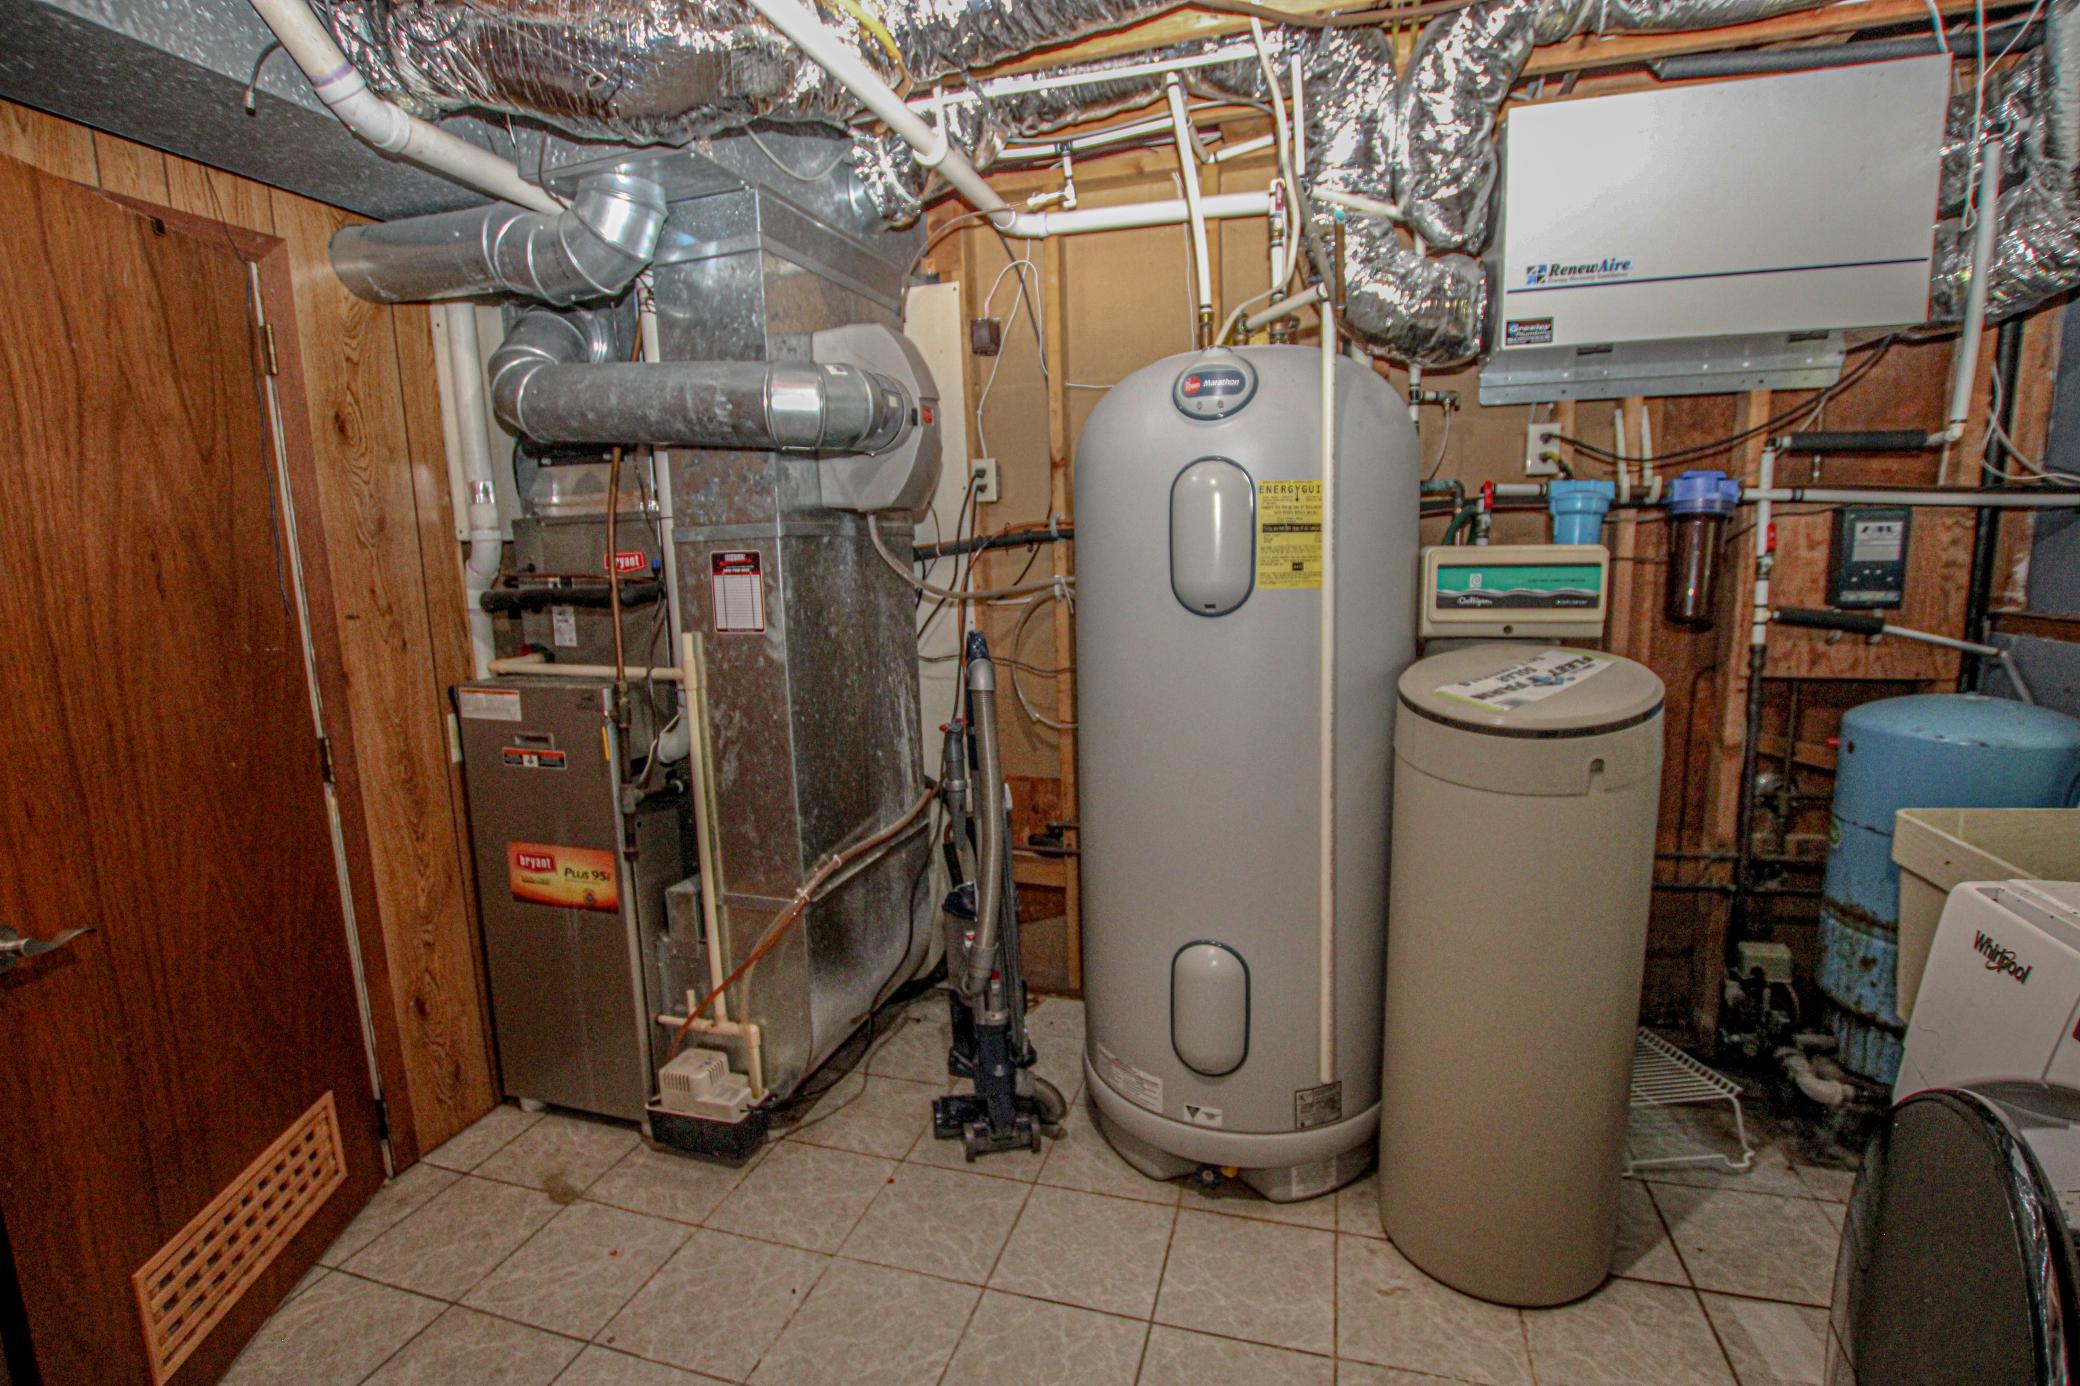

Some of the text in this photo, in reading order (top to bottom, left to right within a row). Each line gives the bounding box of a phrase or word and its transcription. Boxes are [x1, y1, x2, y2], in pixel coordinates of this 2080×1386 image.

[1549, 257, 1632, 277] RenewAire
[1203, 378, 1240, 387] Marathon
[1259, 485, 1320, 496] ENERGYGUI
[615, 555, 640, 569] ryant
[1457, 596, 1492, 607] Culligan
[519, 854, 552, 869] bryant
[1973, 930, 2033, 984] Whirlpool
